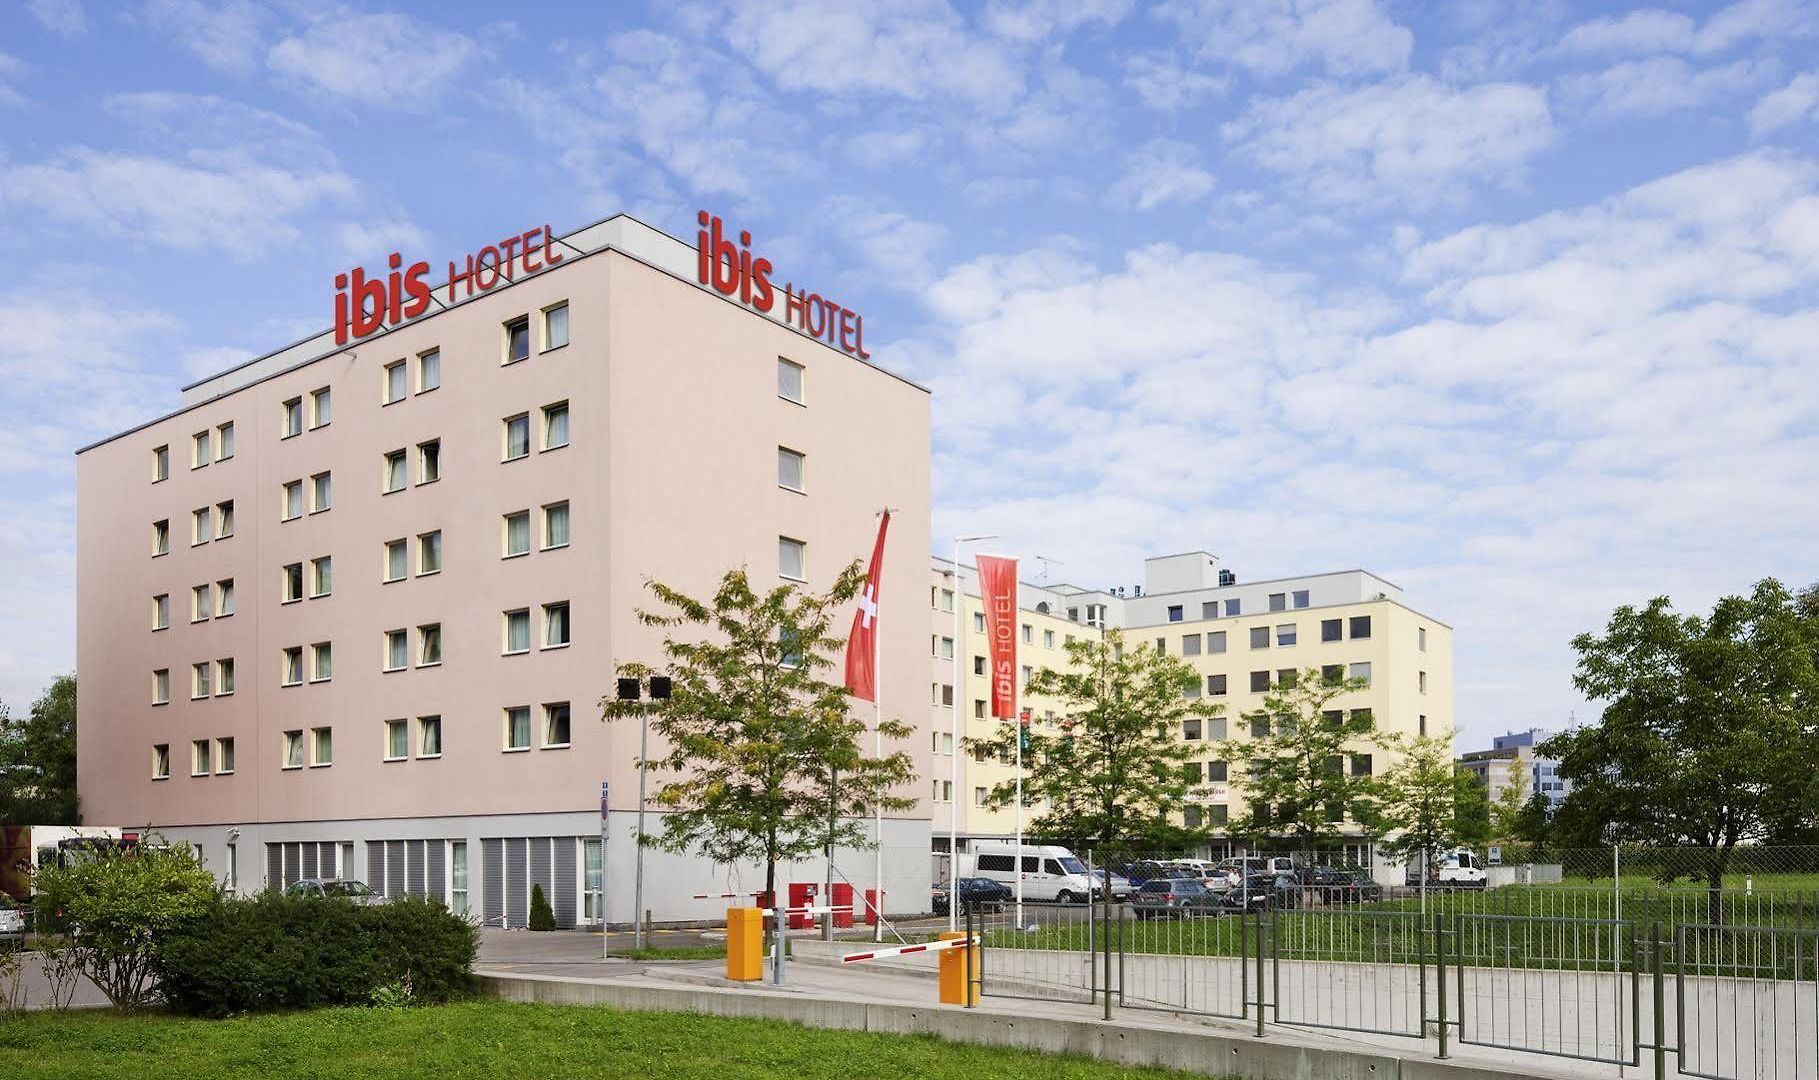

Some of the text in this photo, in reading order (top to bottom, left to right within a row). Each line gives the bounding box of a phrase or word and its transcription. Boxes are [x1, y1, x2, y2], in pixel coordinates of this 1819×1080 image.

[334, 224, 563, 346] ibis HOTEL
[698, 210, 870, 359] ibis HOTEL
[995, 588, 1012, 702] ibis HOTEL
